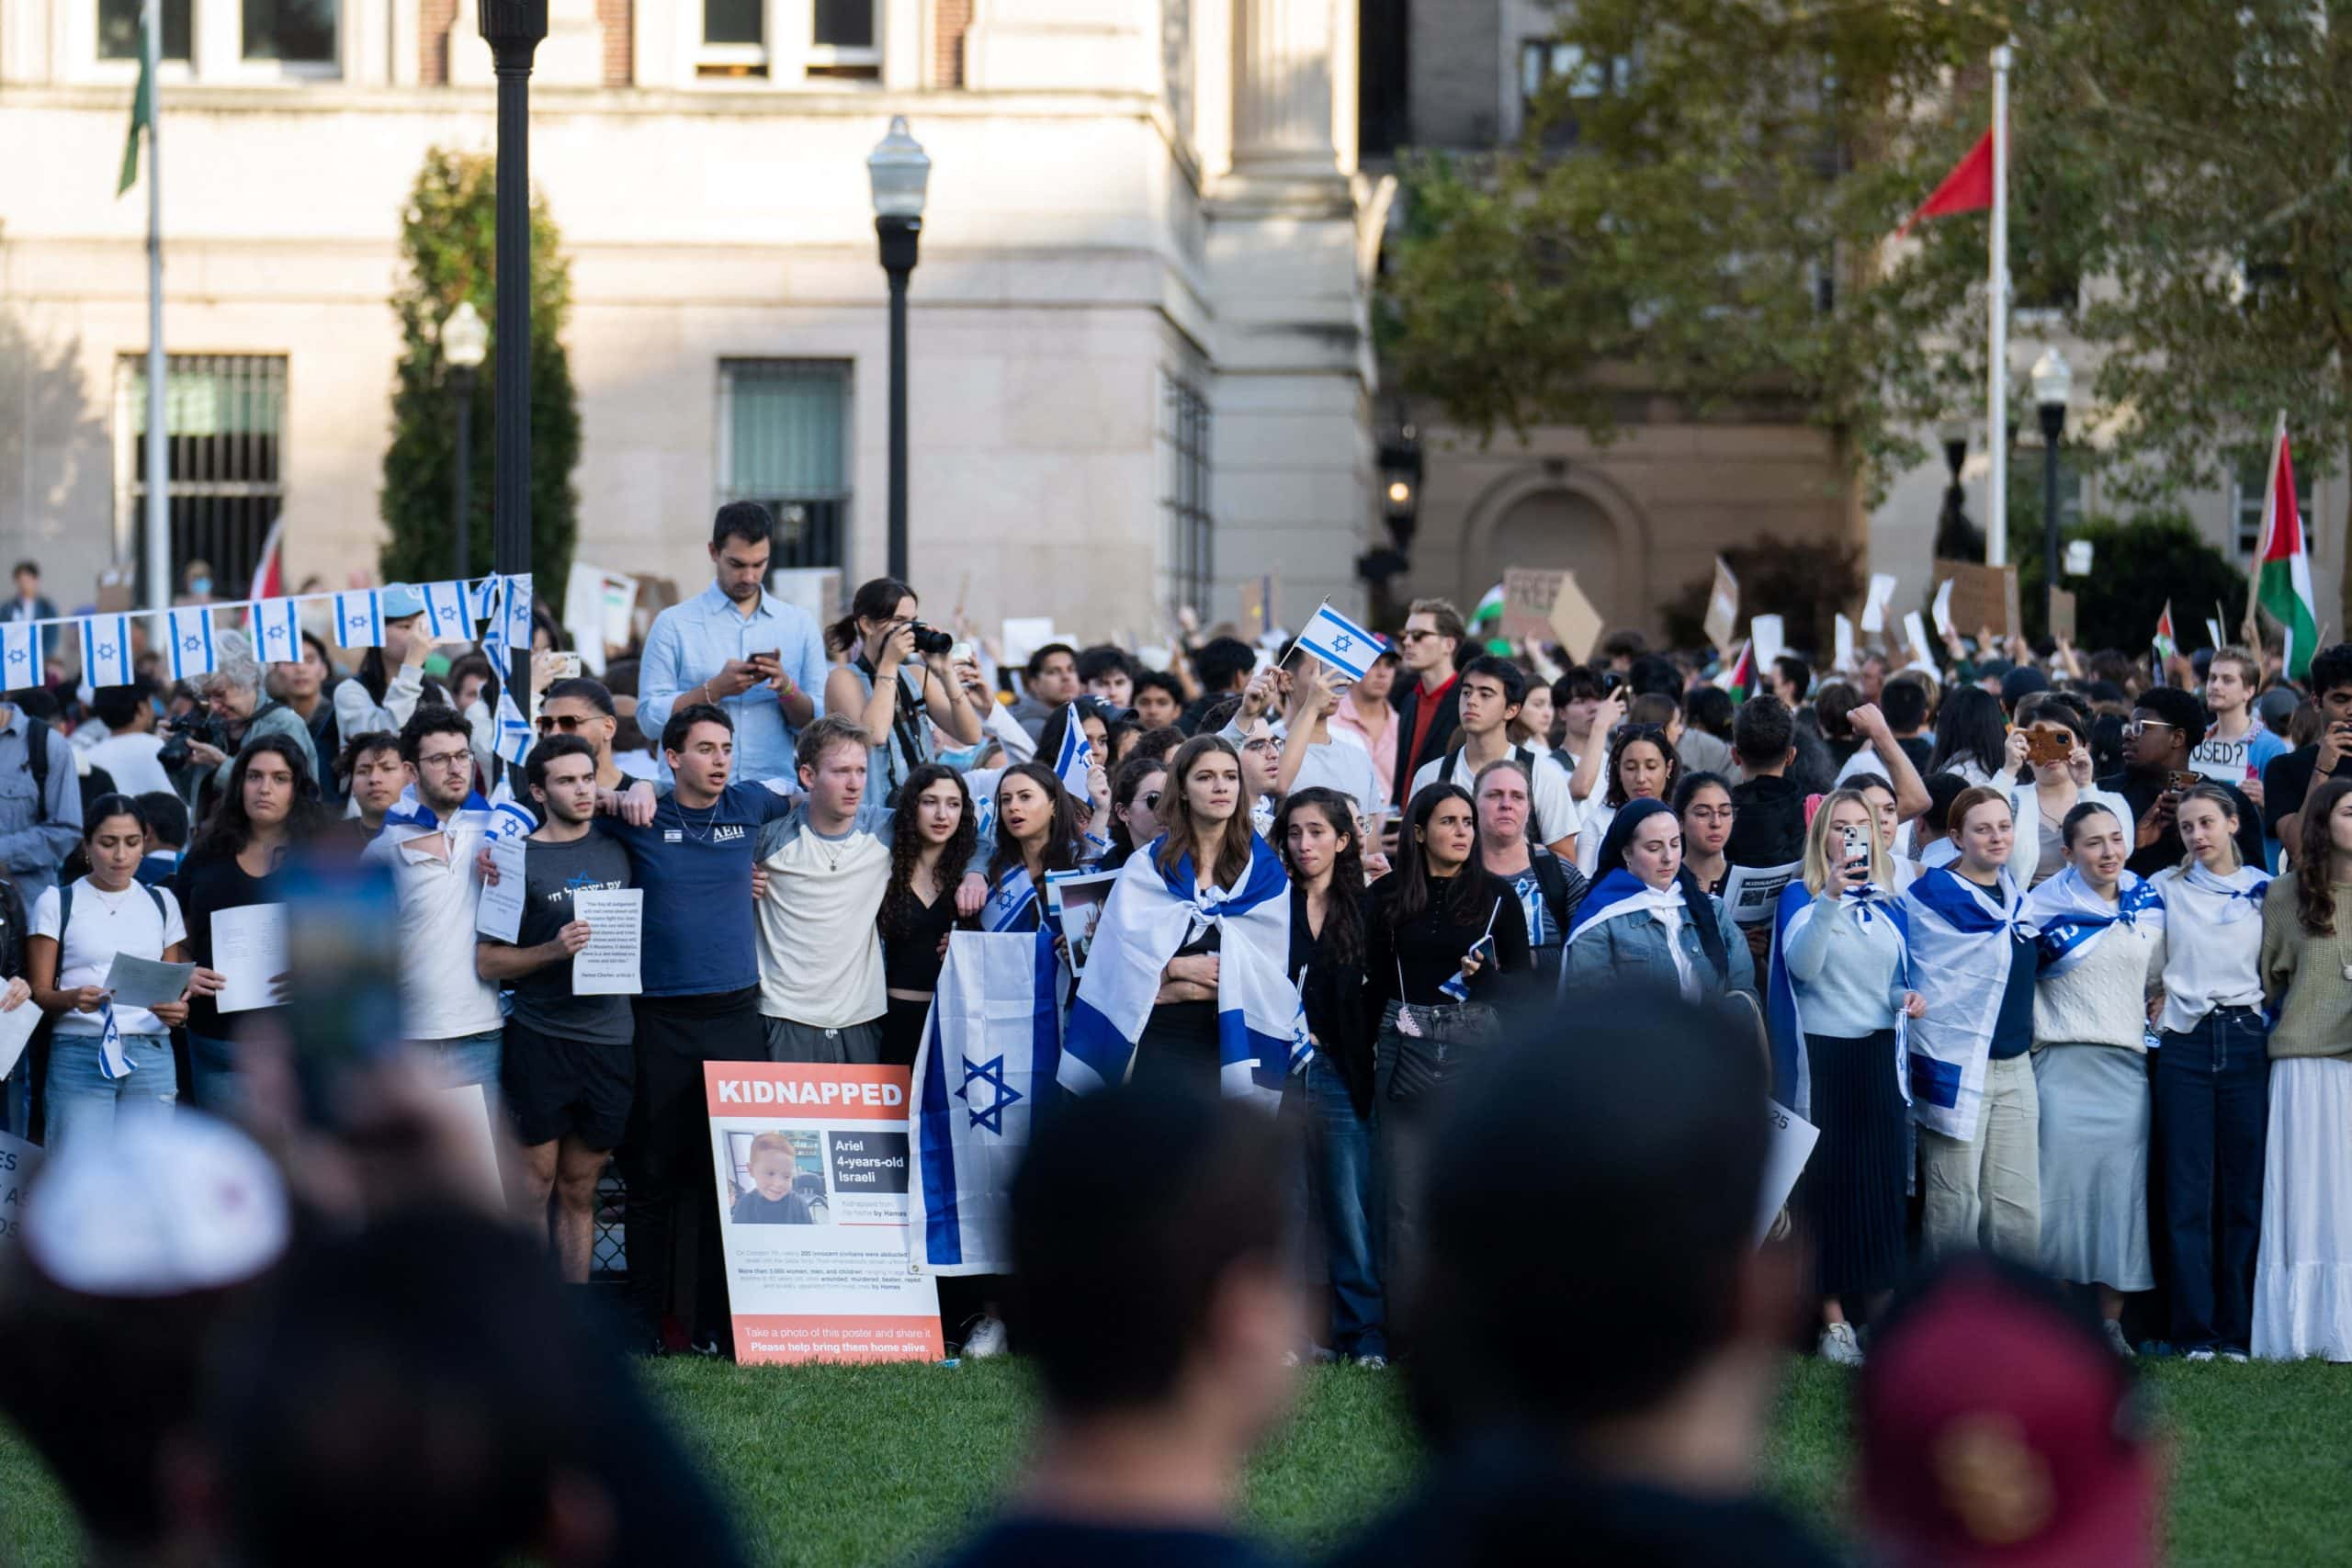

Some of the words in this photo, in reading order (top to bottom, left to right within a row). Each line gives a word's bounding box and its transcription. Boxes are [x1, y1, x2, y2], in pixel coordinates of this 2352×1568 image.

[1745, 875, 1789, 886] KIDNAPPED
[718, 1080, 902, 1106] KIDNAPPED
[835, 1140, 864, 1152] Ariel
[837, 1156, 904, 1169] 4-years-old
[839, 1171, 876, 1183] Israeli
[744, 1326, 769, 1337] Take
[771, 1329, 778, 1337] a
[779, 1327, 808, 1339] photo
[810, 1327, 820, 1337] of
[822, 1327, 840, 1338] this
[842, 1328, 872, 1340] poster
[875, 1328, 894, 1338] and
[896, 1328, 923, 1338] share
[751, 1342, 786, 1352] Please
[787, 1342, 810, 1354] help
[812, 1342, 840, 1354] bring
[842, 1342, 868, 1352] them
[870, 1342, 899, 1352] home
